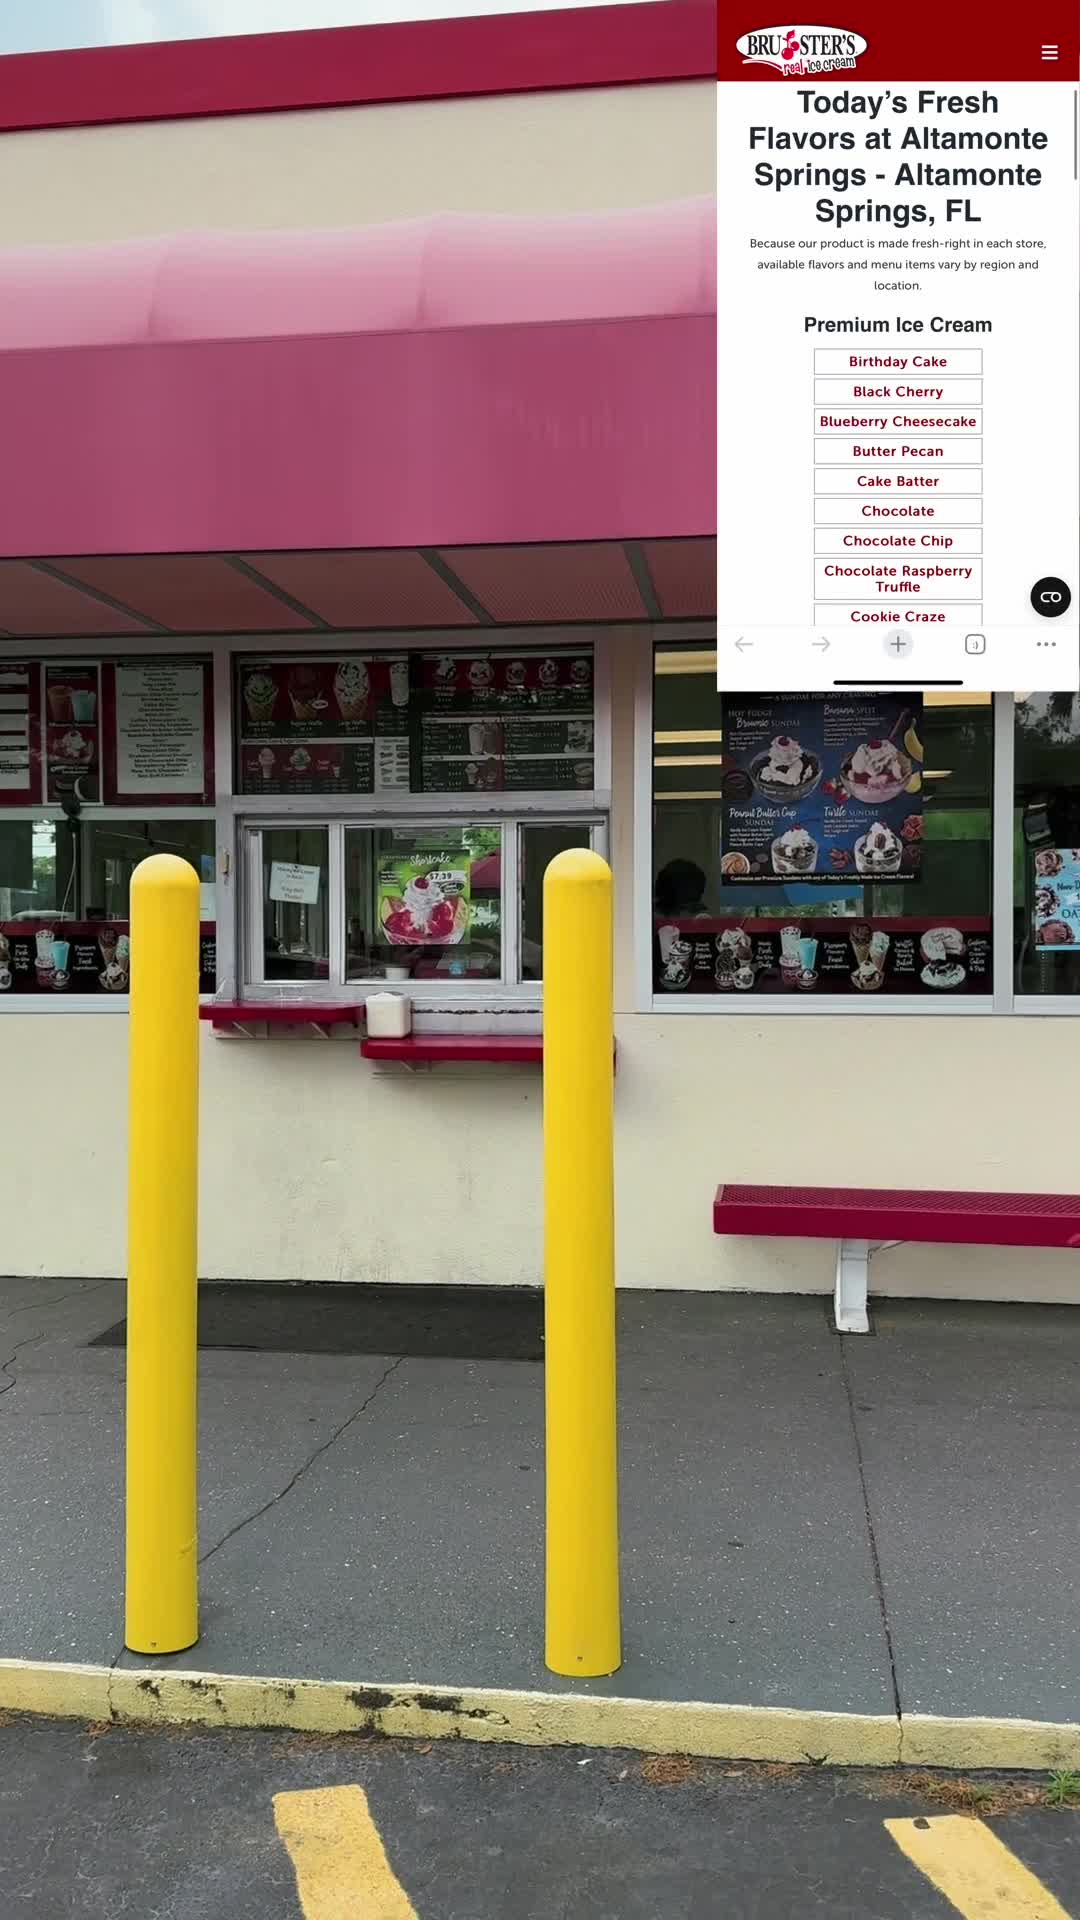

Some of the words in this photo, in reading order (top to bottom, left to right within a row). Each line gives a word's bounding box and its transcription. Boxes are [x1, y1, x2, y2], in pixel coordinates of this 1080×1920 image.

[823, 704, 855, 715] Banana
[736, 717, 769, 728] Brownie
[770, 719, 801, 728] SUNDAE
[729, 807, 755, 818] Peanut
[756, 807, 780, 818] Butter
[781, 806, 797, 819] Cup
[823, 806, 847, 817] Turtle
[848, 809, 880, 817] SUNDAE
[744, 819, 775, 827] SUNDAE
[410, 852, 451, 865] Shortcake
